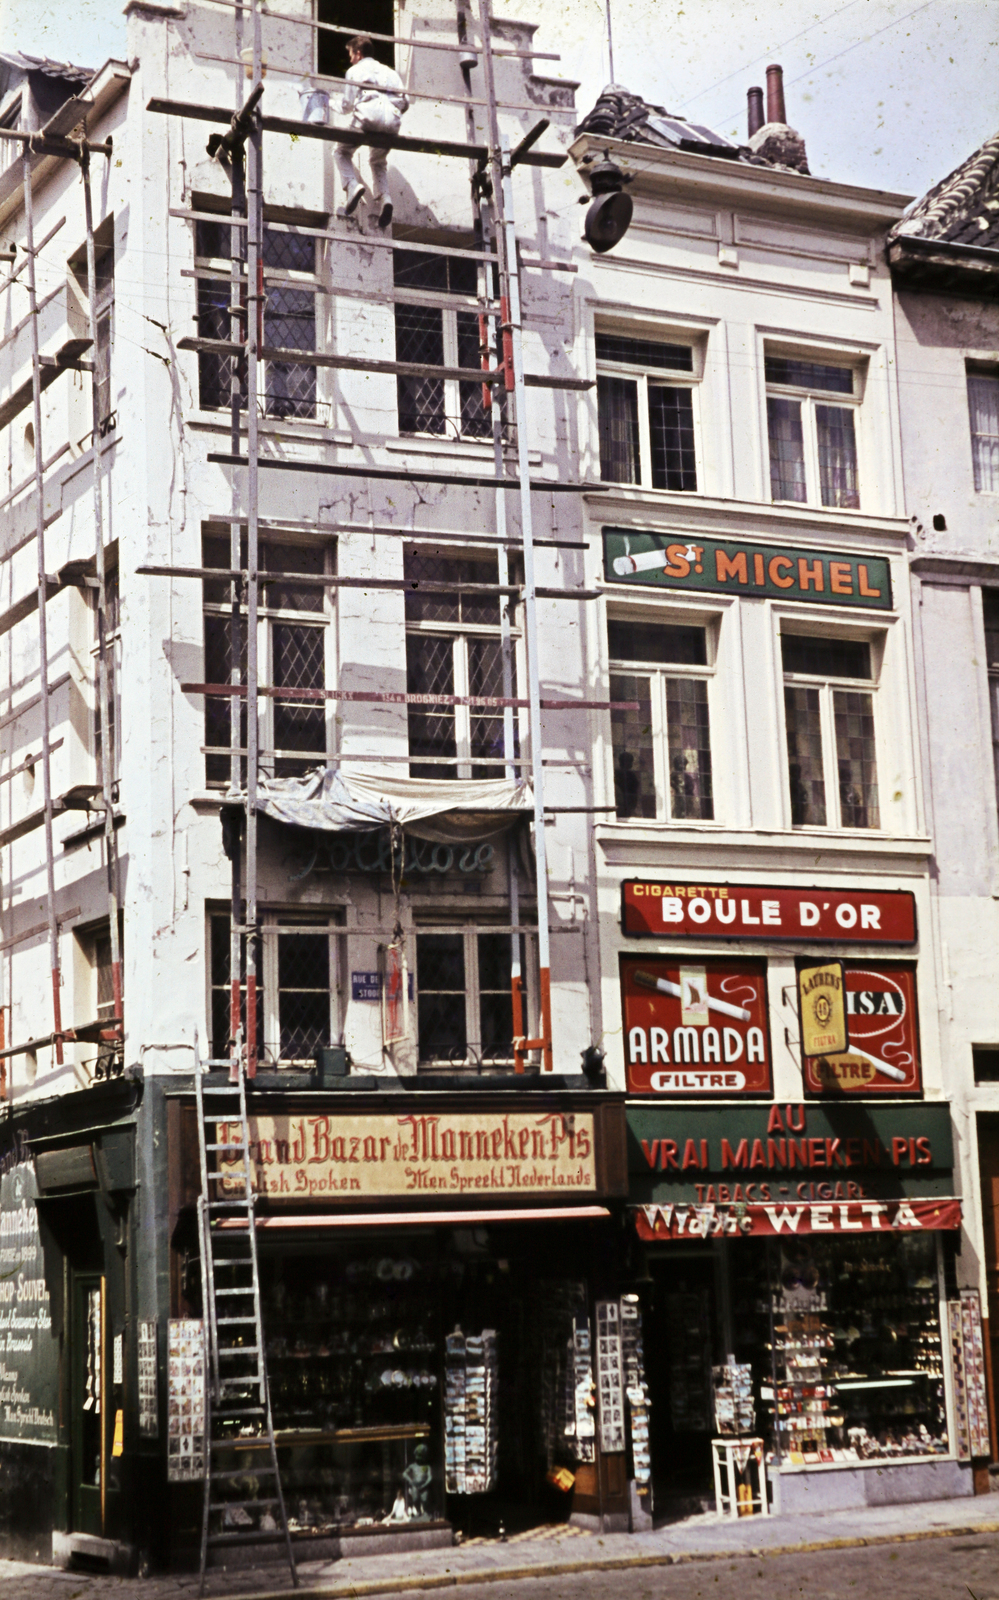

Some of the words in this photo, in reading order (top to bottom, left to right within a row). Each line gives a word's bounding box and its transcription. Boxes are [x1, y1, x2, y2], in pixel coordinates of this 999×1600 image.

[715, 549, 881, 598] MICHEL
[632, 884, 729, 899] CIGARETTE
[662, 897, 782, 925] BOULE
[799, 901, 881, 929] D'OR
[802, 972, 841, 996] LAURENS
[846, 991, 900, 1015] ISA
[629, 1026, 765, 1065] ARMADA
[659, 1074, 738, 1087] FILTRE
[816, 1062, 872, 1079] FILTRE
[767, 1104, 806, 1133] AU
[308, 1115, 391, 1164] Bazar
[393, 1130, 410, 1161] de
[641, 1138, 708, 1169] VRAI
[295, 1169, 361, 1196] Spoken
[405, 1166, 447, 1189] Men
[450, 1166, 506, 1192] Spreekt
[507, 1165, 591, 1188] Nederlands
[695, 1183, 771, 1202] TABACS
[763, 1203, 922, 1232] WELTA
